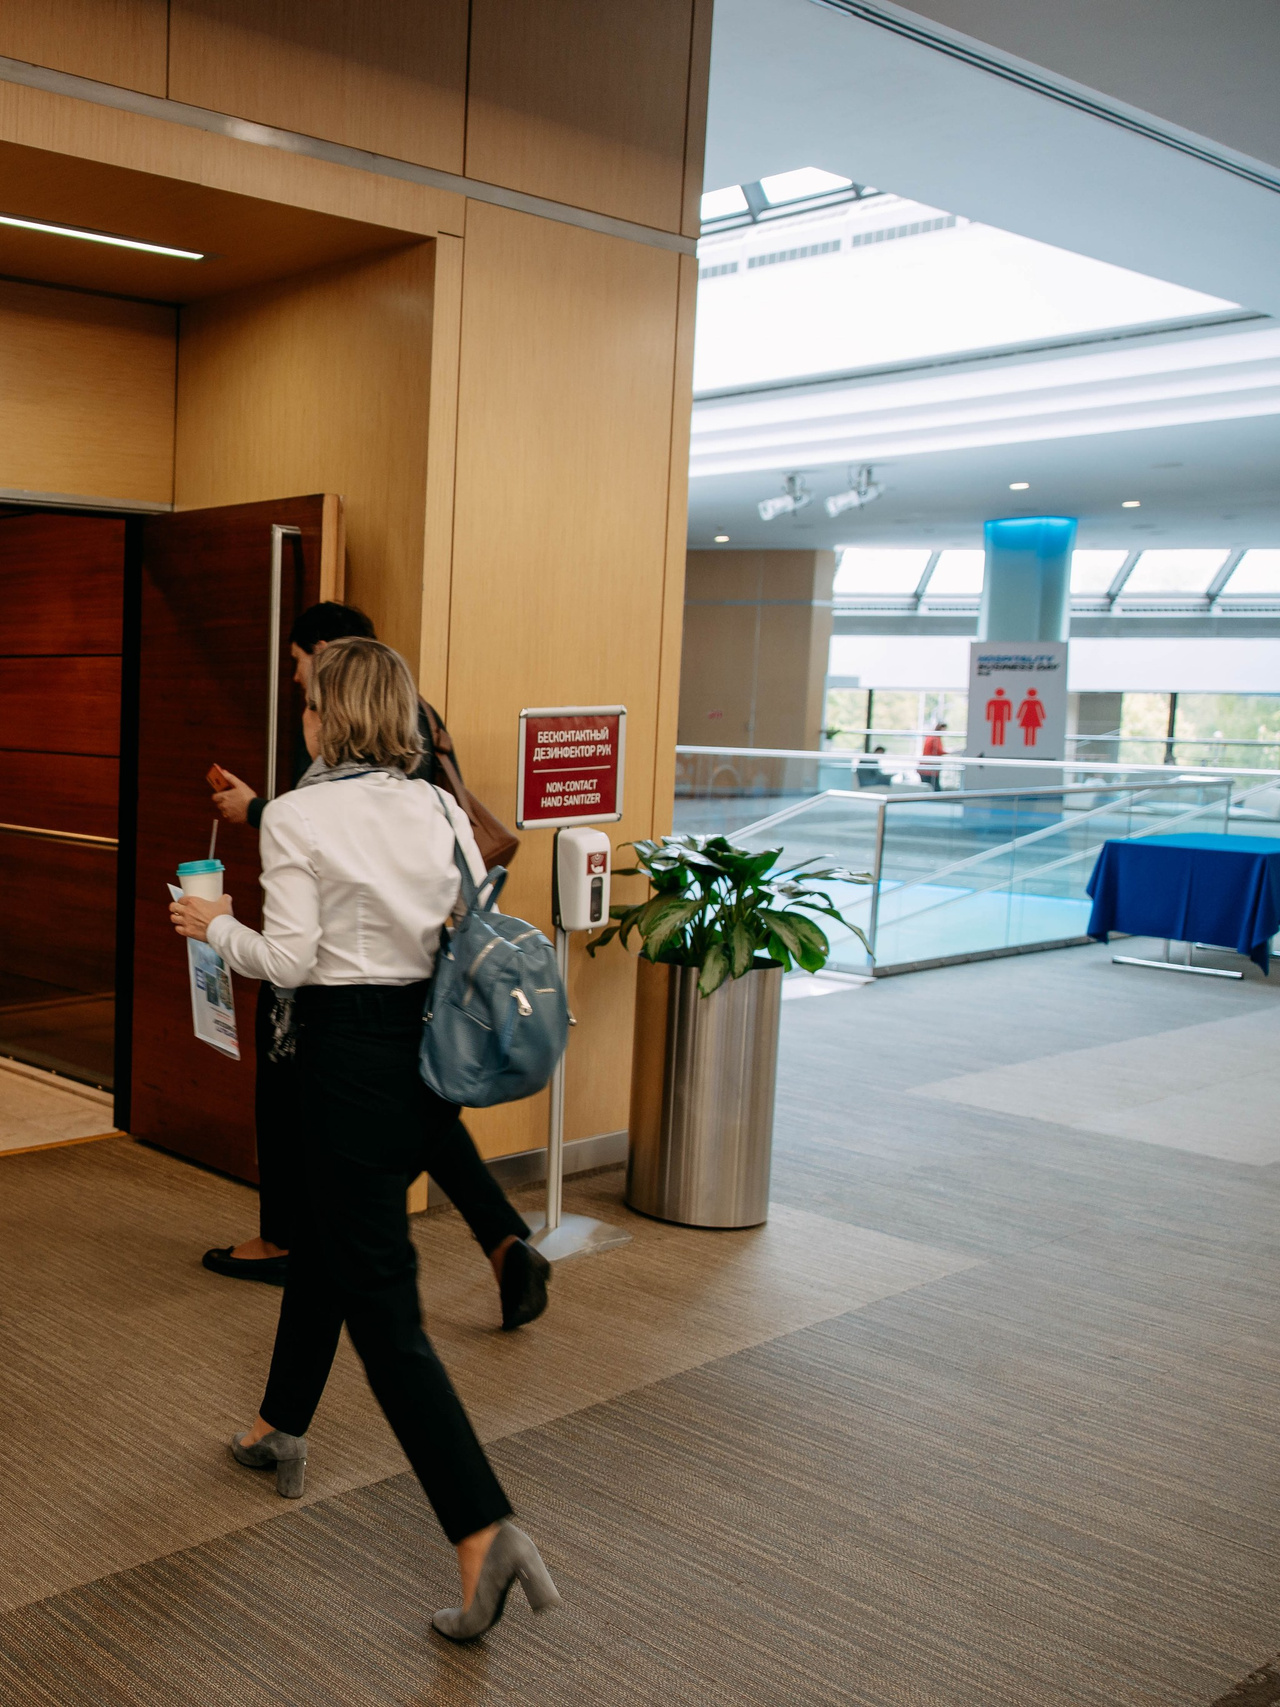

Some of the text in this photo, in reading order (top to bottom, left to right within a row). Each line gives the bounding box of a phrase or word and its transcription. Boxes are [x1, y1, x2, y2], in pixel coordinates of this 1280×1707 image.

[537, 727, 609, 743] БЕСКОНТАКТНЫЙ
[533, 744, 611, 761] ДЕЗИНФЕКТОР РУК
[546, 779, 598, 793] NON-CONTACT
[541, 793, 601, 808] HAND SANITIZER
